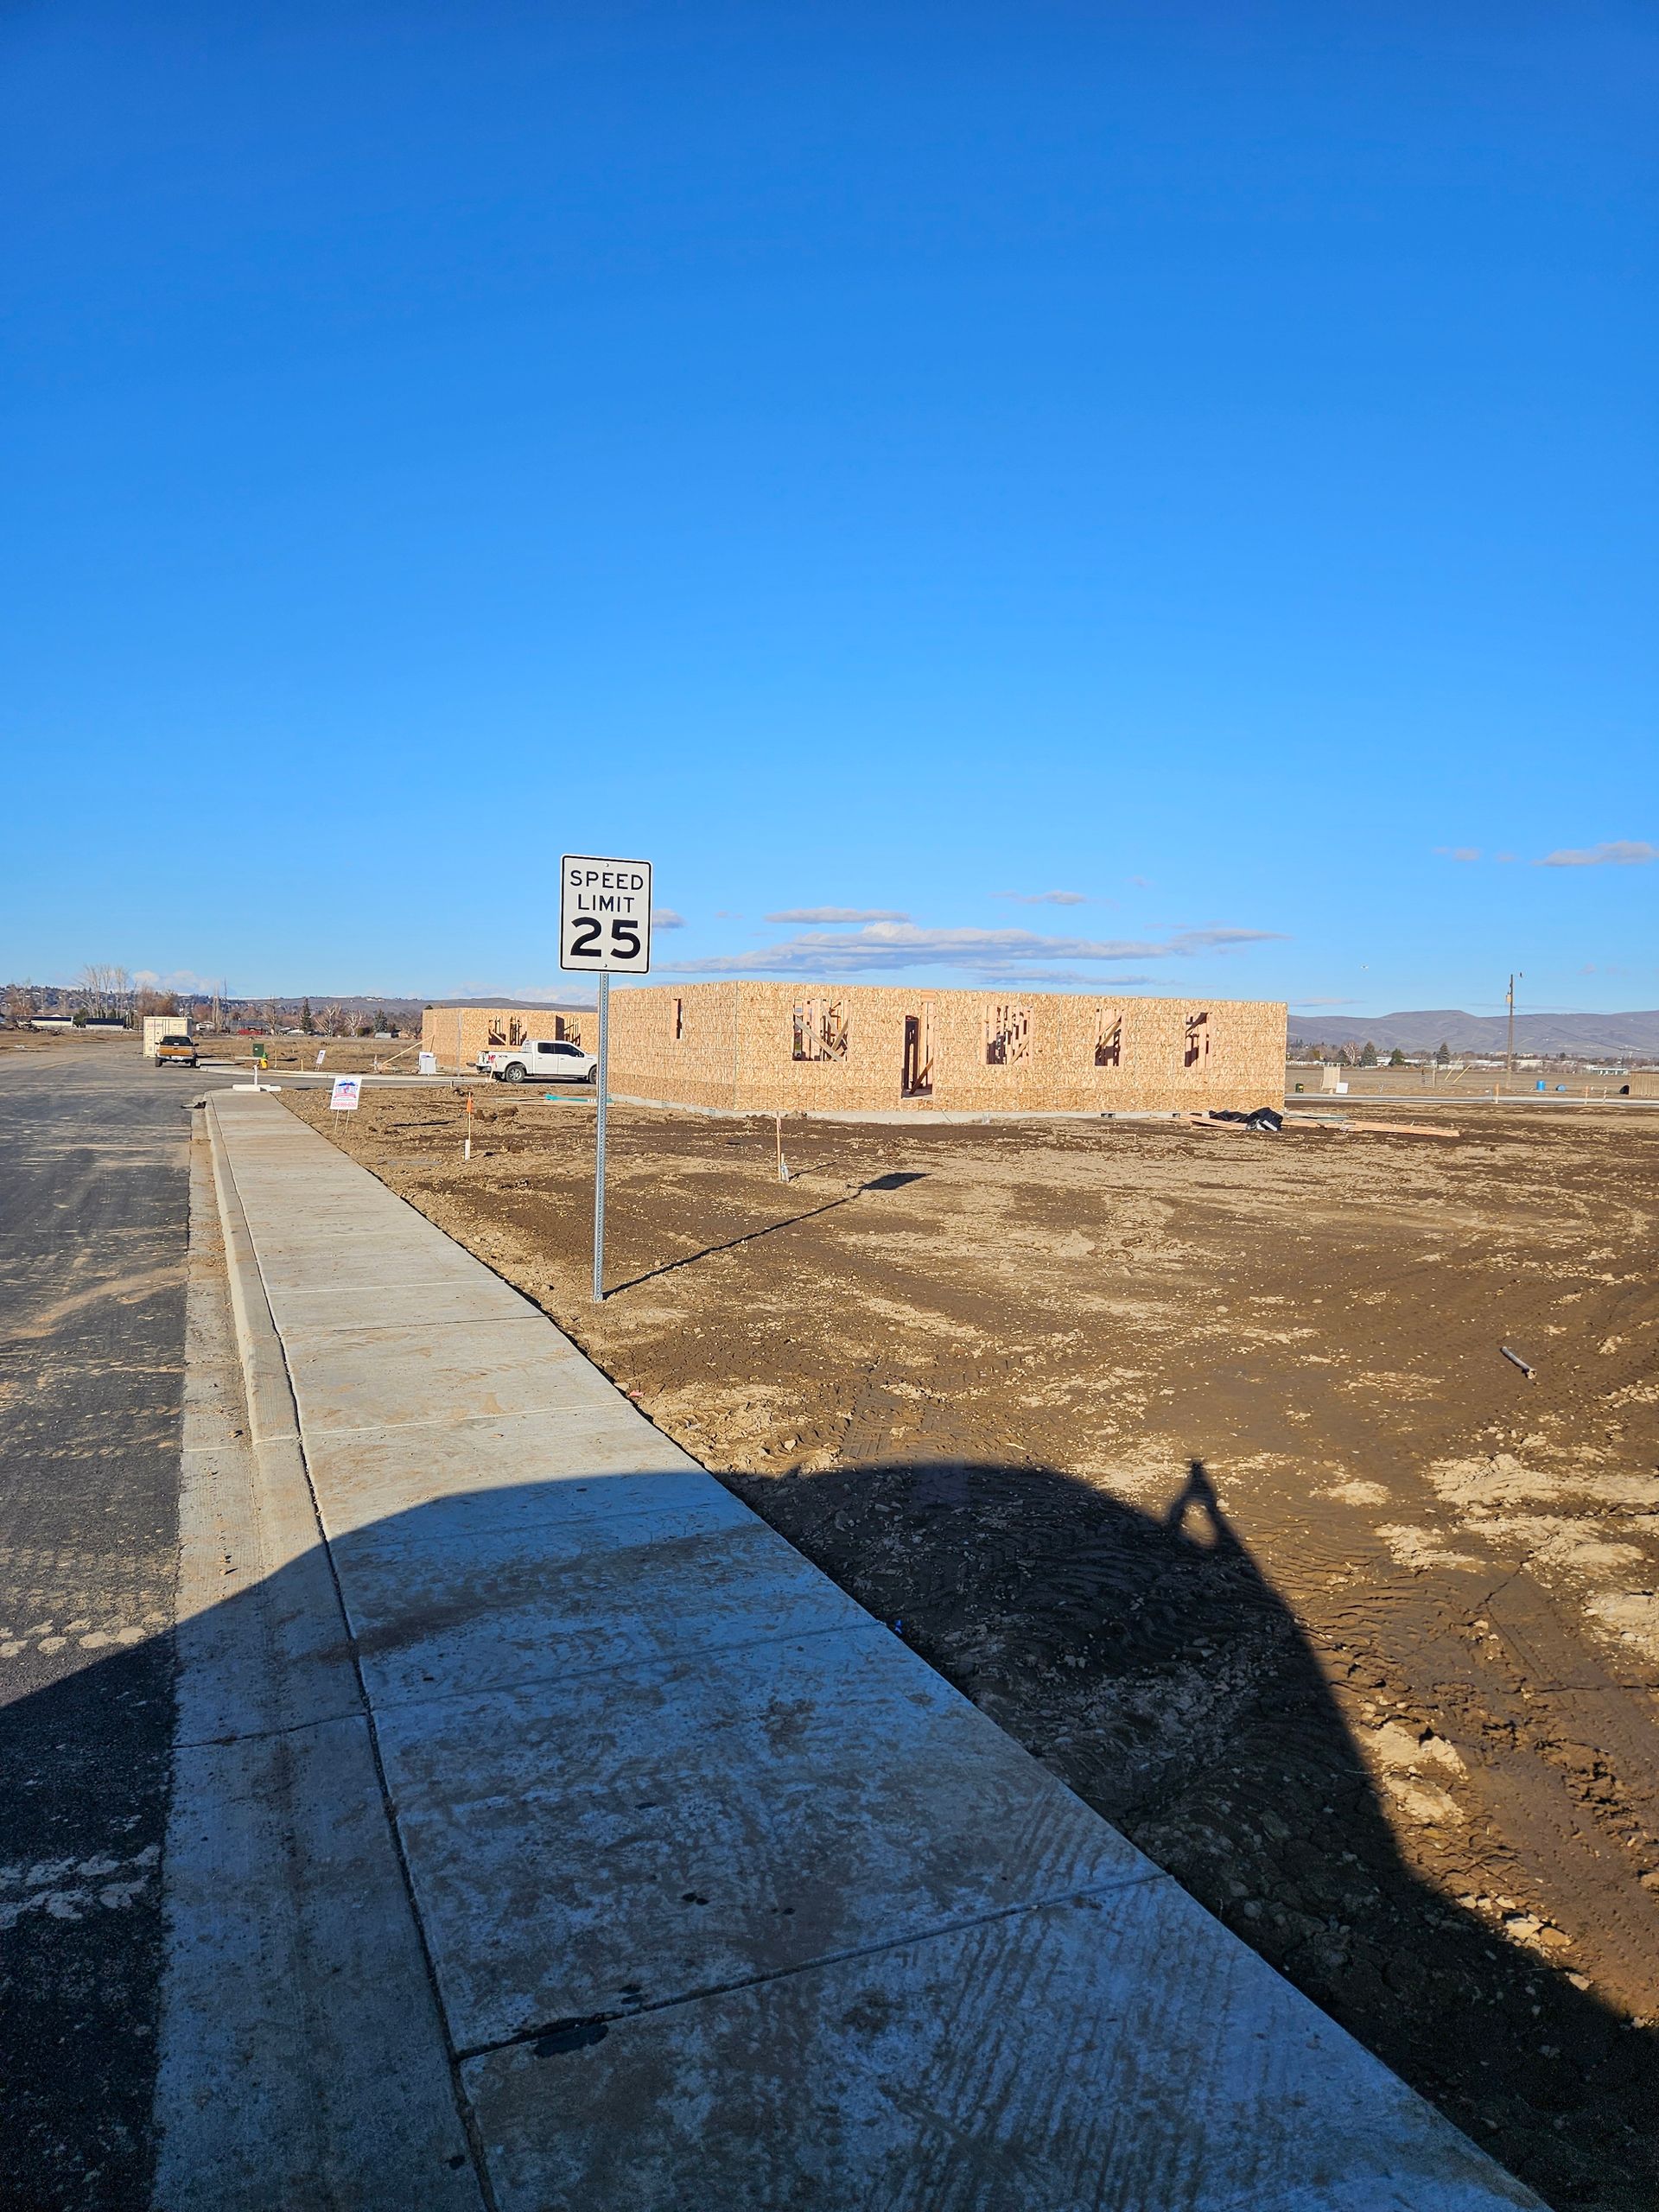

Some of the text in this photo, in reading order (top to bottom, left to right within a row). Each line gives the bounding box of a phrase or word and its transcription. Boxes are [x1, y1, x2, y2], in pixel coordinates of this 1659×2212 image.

[569, 869, 644, 890] SPEED
[577, 893, 634, 912] LIMIT
[570, 916, 641, 959] 25
